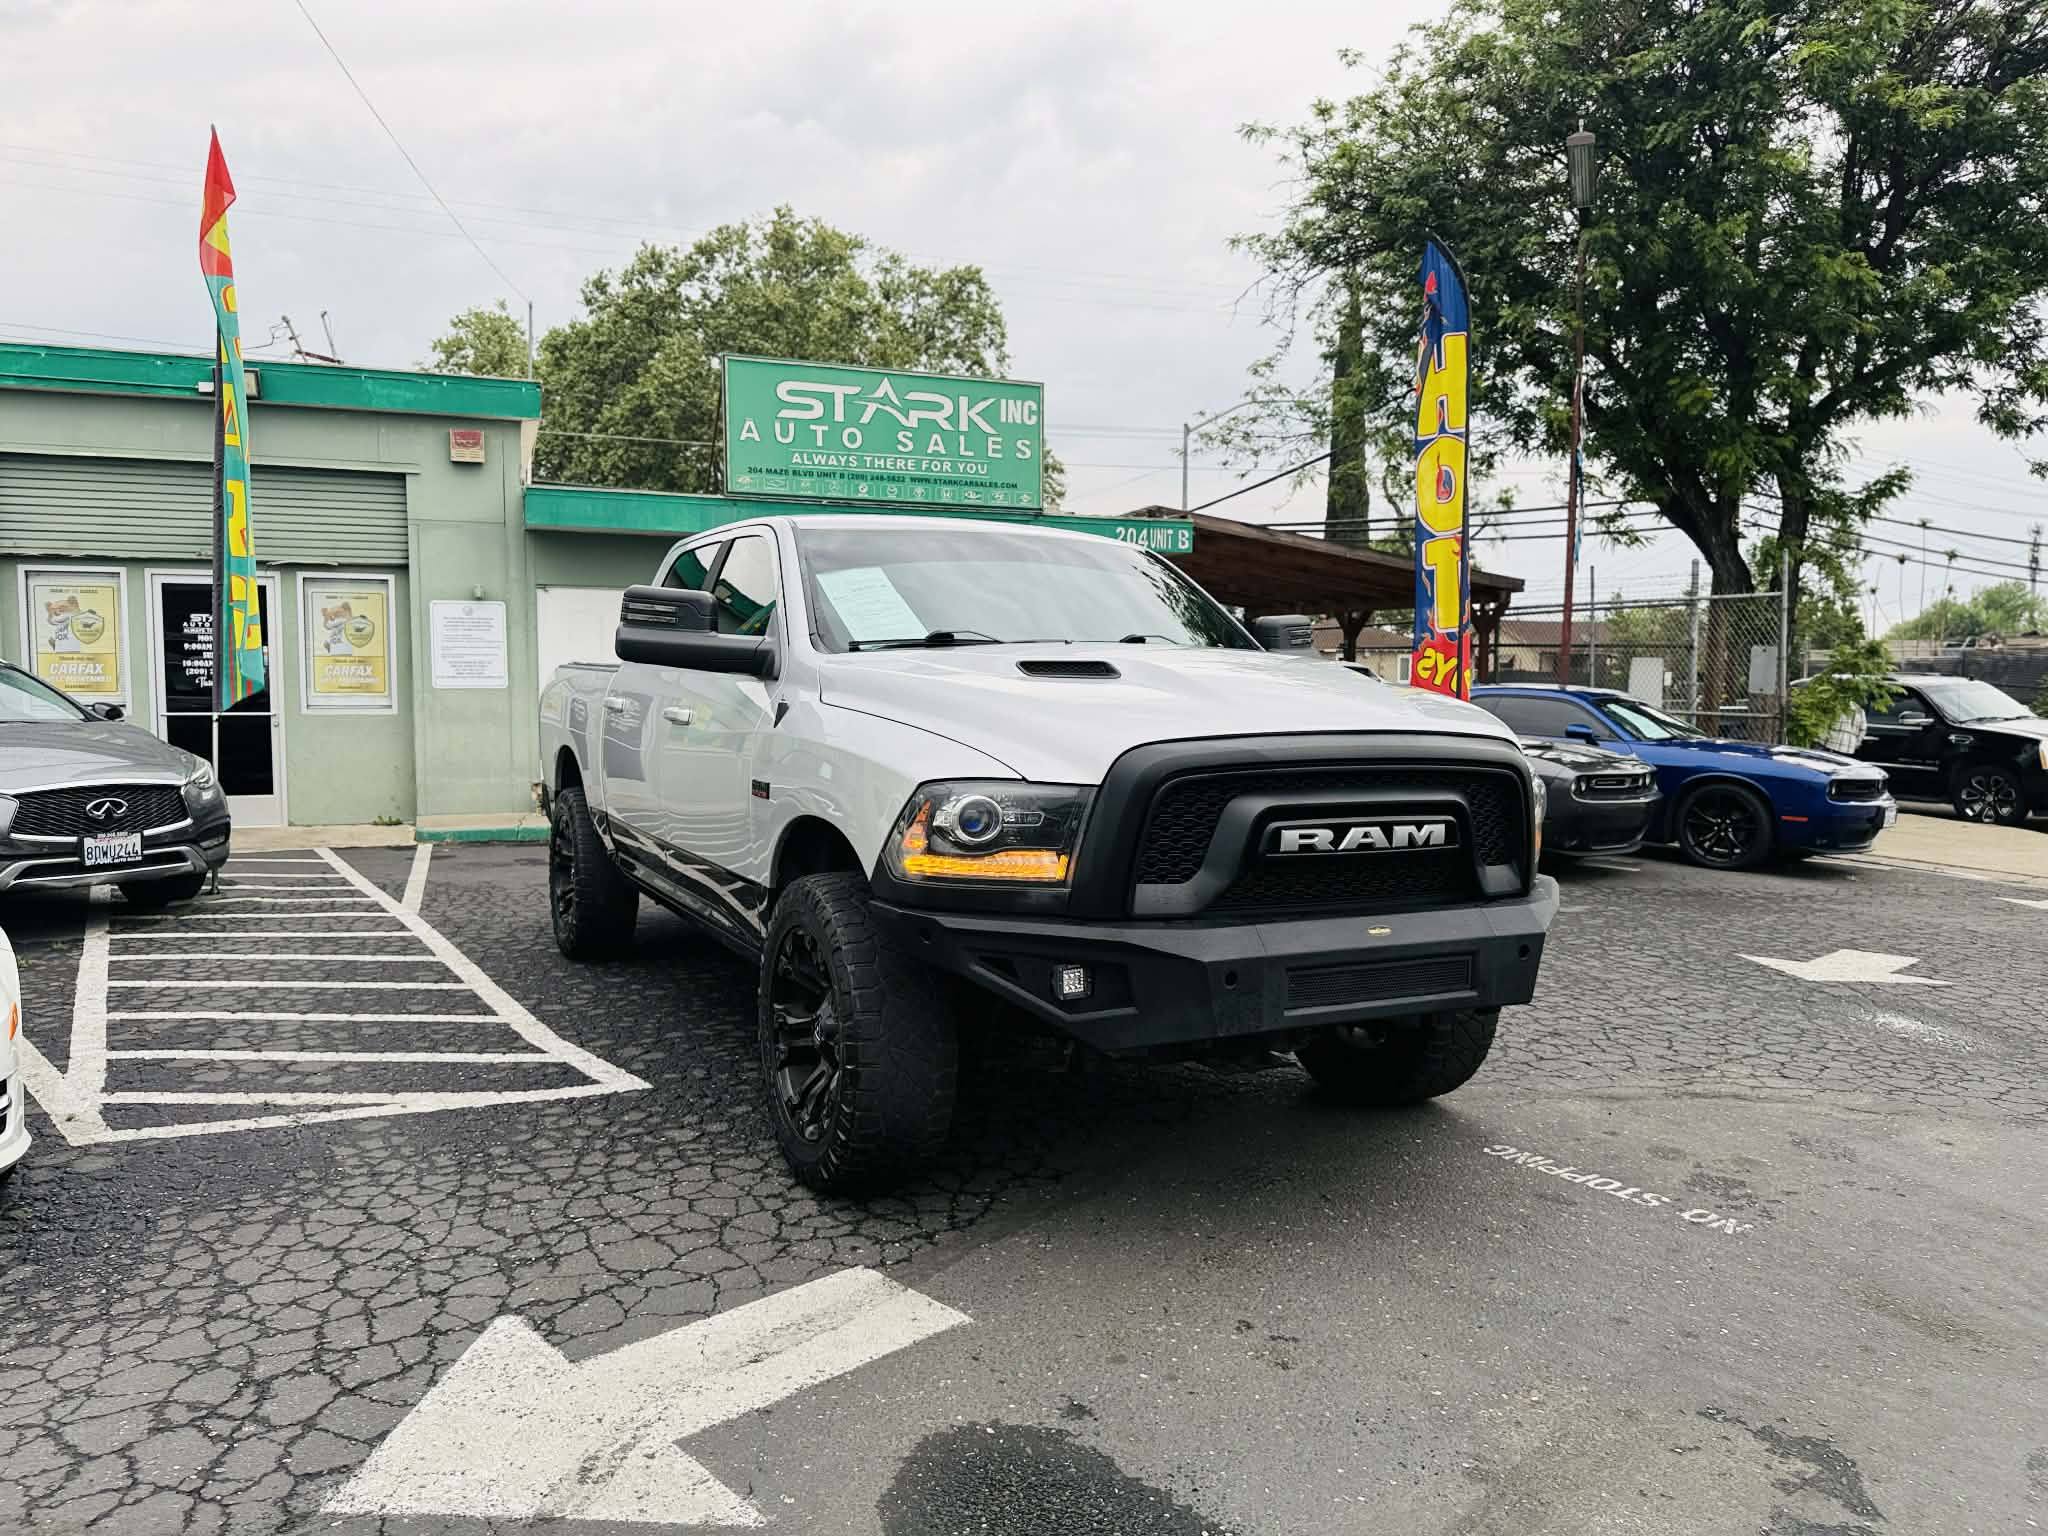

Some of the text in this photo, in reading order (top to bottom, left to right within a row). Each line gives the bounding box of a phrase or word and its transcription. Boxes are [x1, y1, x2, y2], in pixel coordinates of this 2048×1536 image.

[775, 376, 1038, 434] STARK INC
[738, 418, 1033, 460] AUTO SALES
[747, 466, 763, 474] 204
[765, 467, 789, 476] MAZE
[792, 469, 815, 478] BLVD
[816, 471, 837, 479] UNIT
[791, 452, 988, 475] ALWAYS THERE FOR YOU
[1415, 332, 1469, 632] HOT
[1115, 526, 1149, 549] 204
[1177, 529, 1190, 550] B
[49, 663, 105, 675] CARFAX
[1279, 823, 1447, 854] RAM
